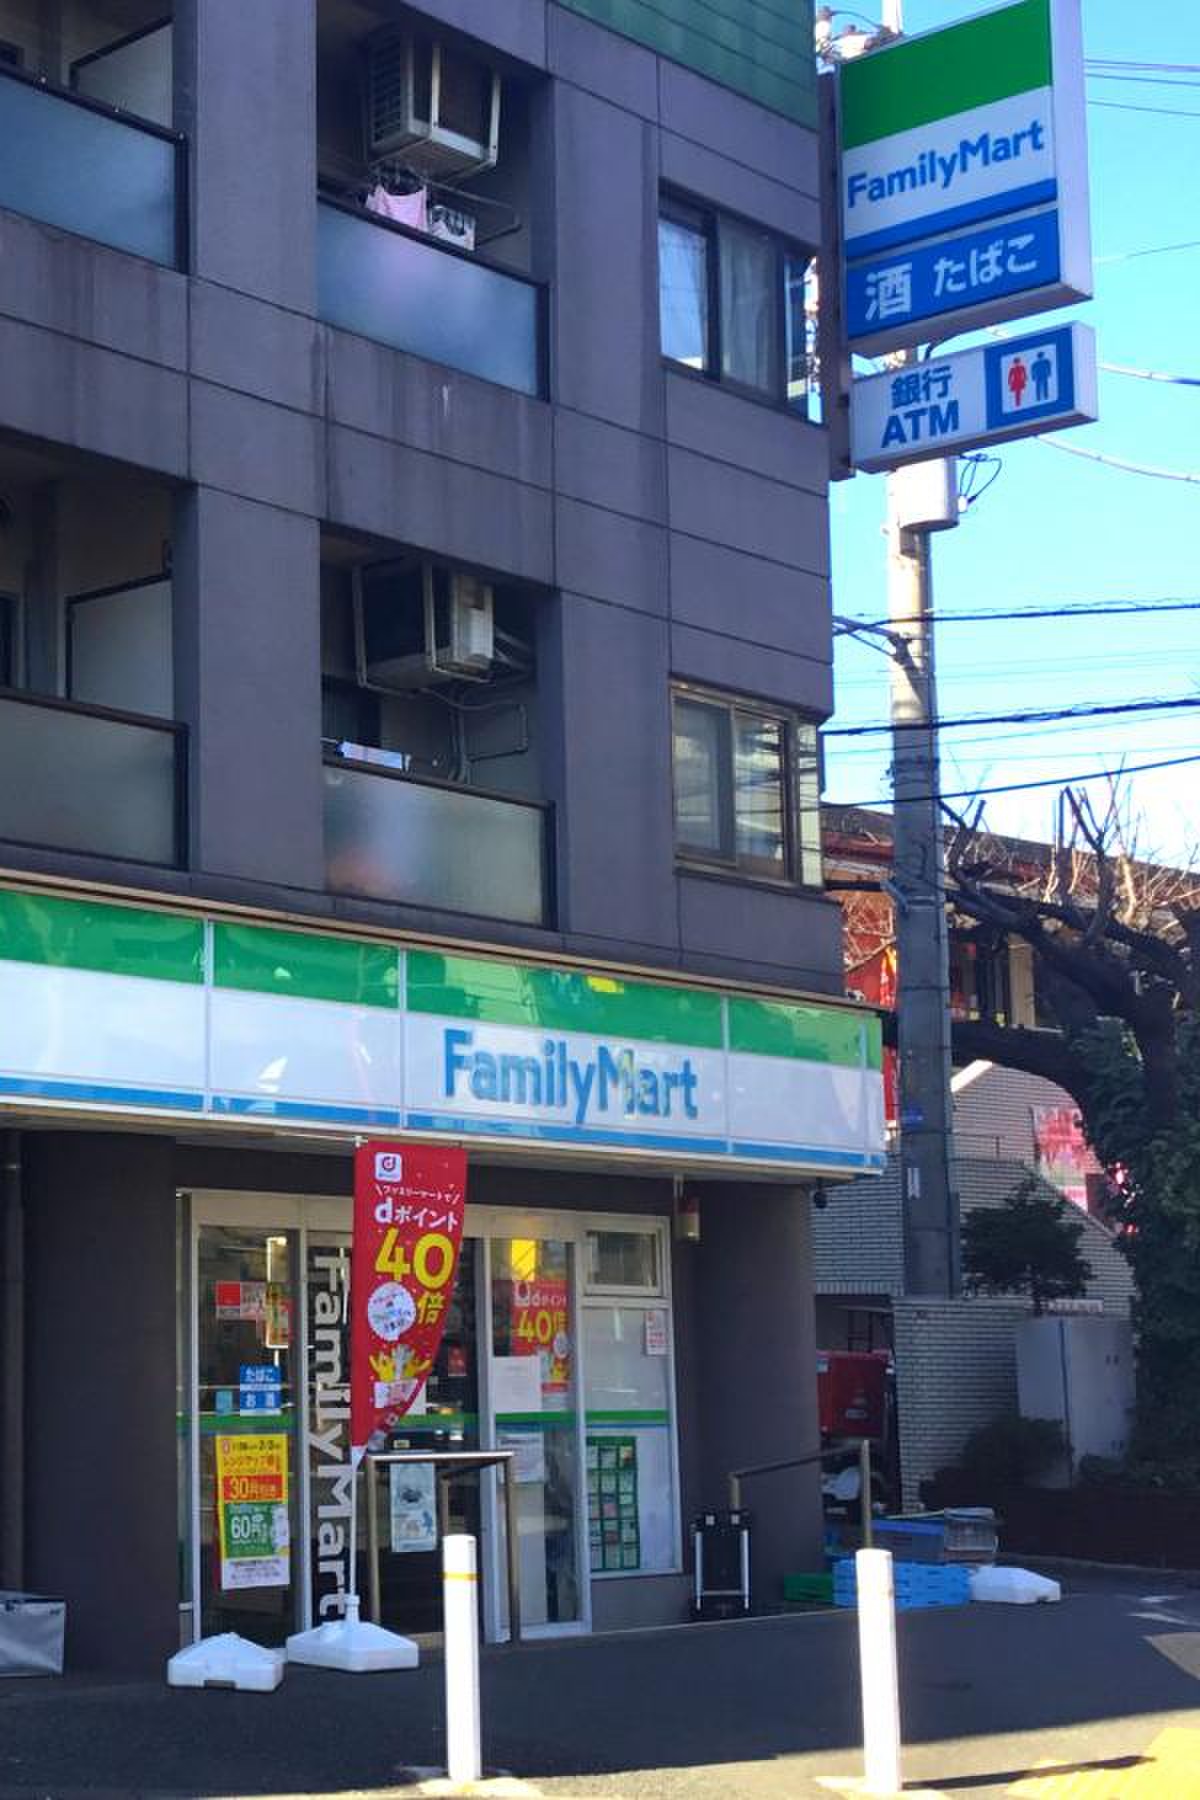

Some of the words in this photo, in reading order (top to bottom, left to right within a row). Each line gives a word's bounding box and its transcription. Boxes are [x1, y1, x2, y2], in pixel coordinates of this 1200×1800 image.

[847, 120, 1045, 208] FamilyMart
[865, 262, 912, 320] 酒
[932, 233, 1038, 297] たばこ
[891, 364, 953, 405] 銀行
[881, 400, 960, 448] ATM
[443, 1028, 699, 1124] FamilyMart
[374, 1197, 459, 1233] dポイント
[374, 1225, 455, 1291] 40
[416, 1290, 445, 1325] 倍
[308, 1255, 353, 1616] FamilyMart
